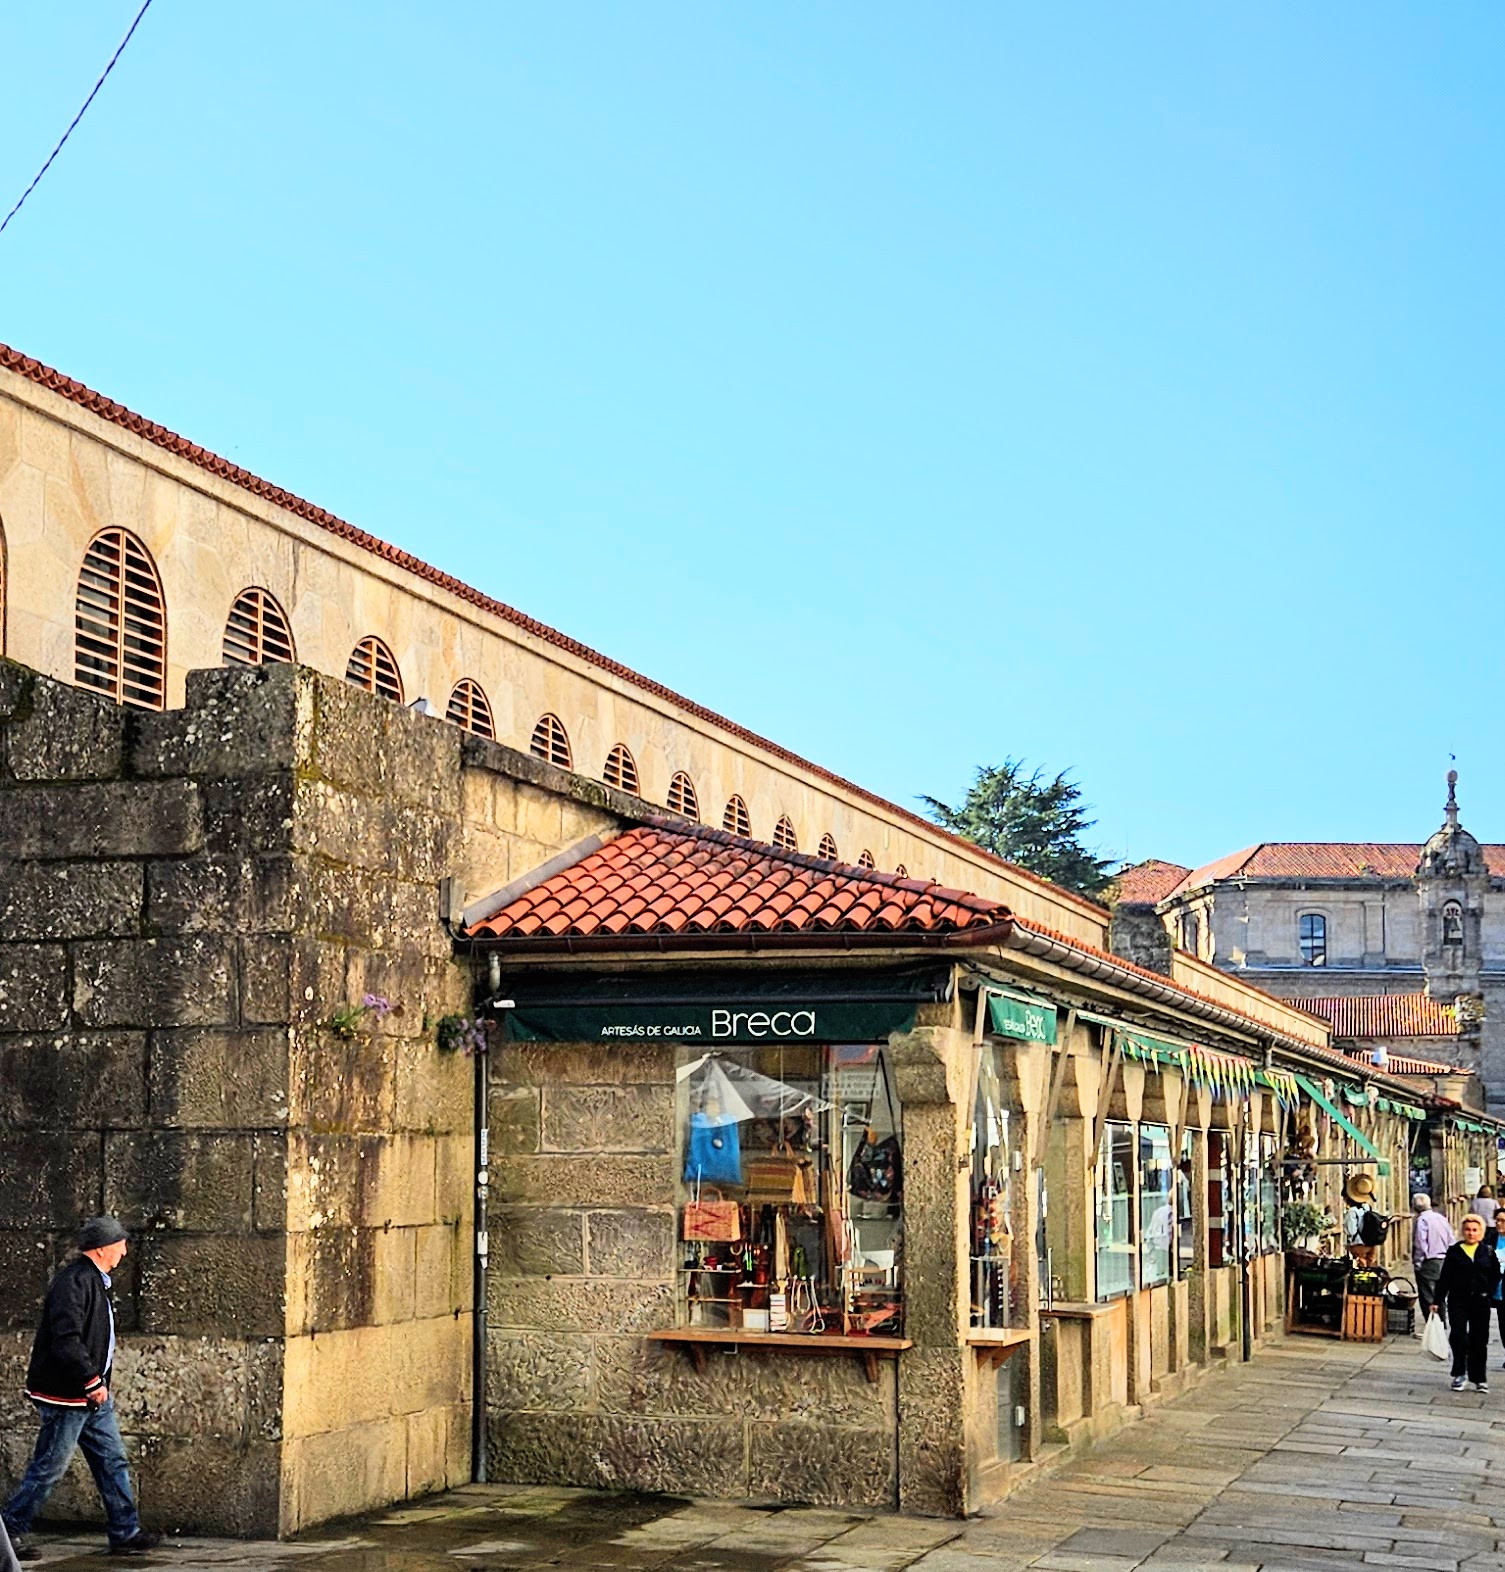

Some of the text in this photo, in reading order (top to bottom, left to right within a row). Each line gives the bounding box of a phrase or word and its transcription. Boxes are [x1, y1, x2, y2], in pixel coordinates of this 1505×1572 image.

[600, 1009, 816, 1037] ARTESÁS DE GALICIA Breca
